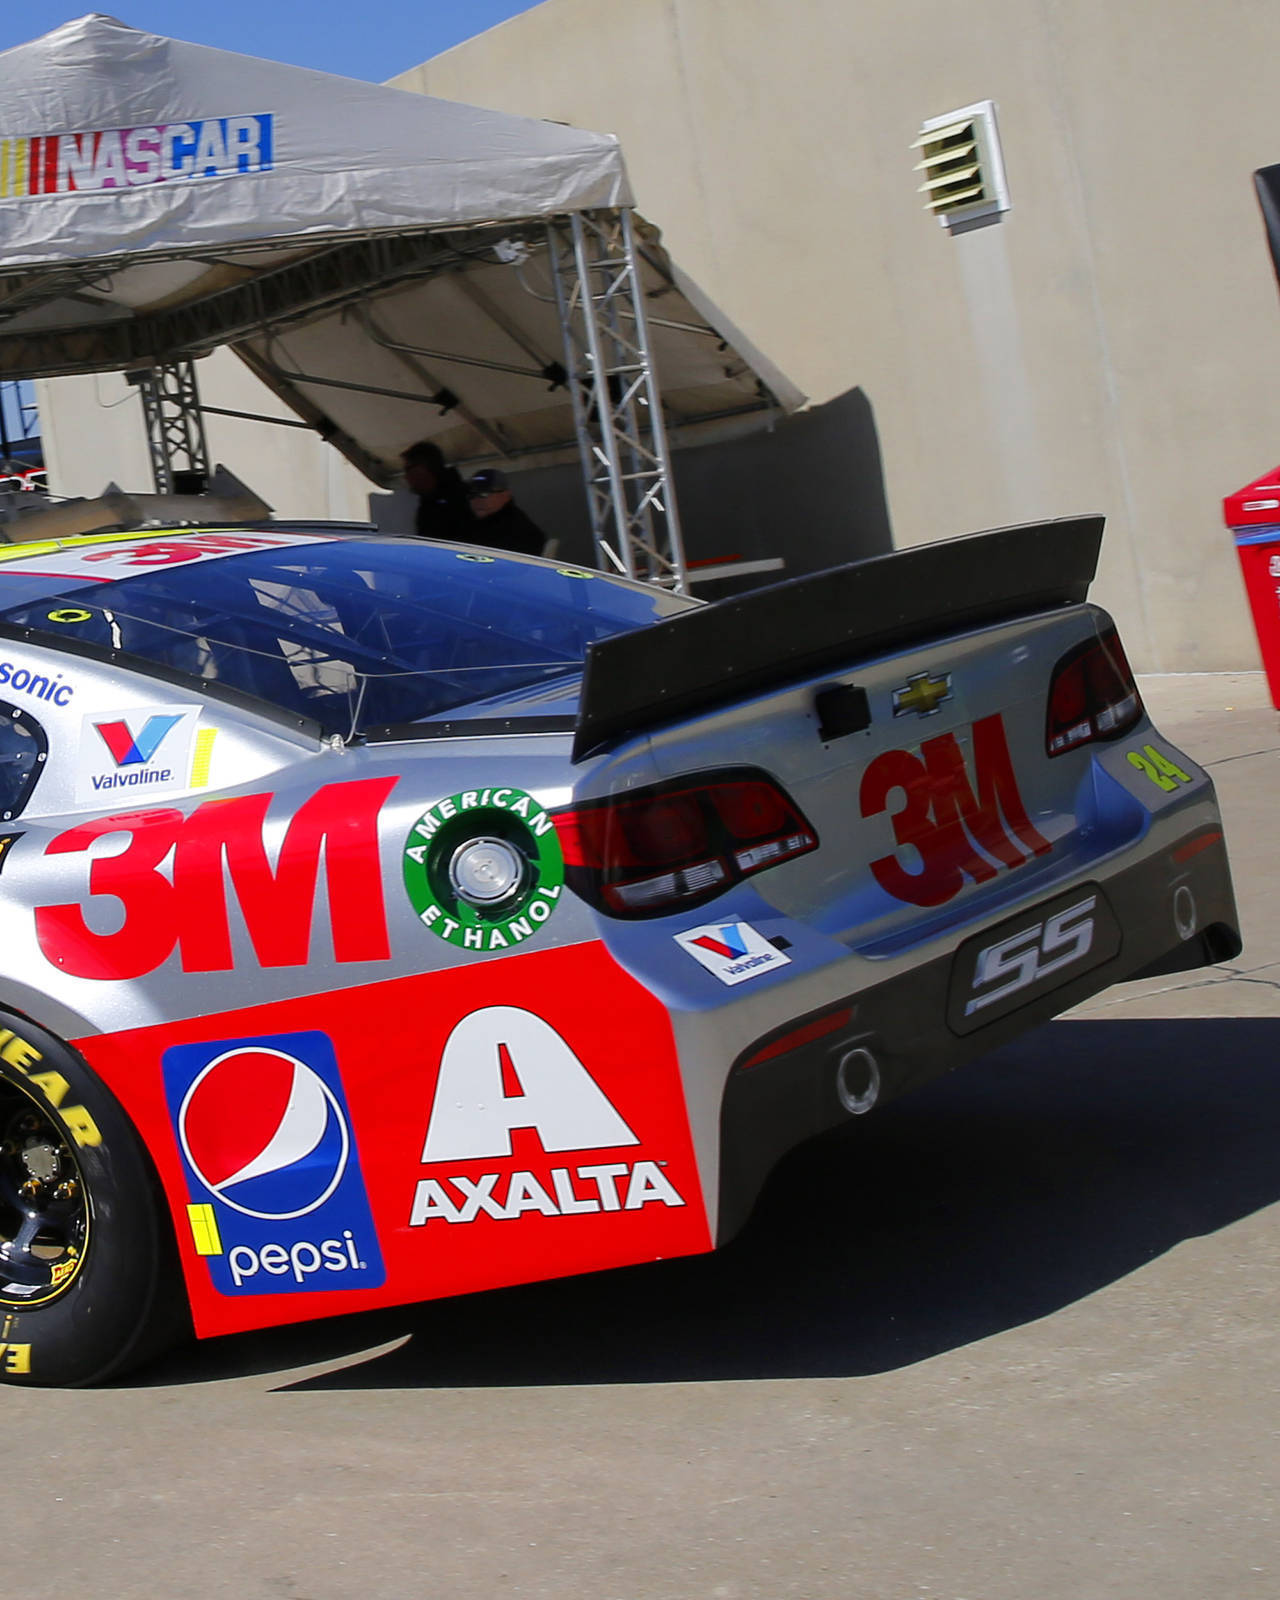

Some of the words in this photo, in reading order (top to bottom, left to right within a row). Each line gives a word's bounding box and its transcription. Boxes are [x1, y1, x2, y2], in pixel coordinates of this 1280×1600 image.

[57, 115, 263, 192] NASCAR
[81, 535, 291, 566] 3M
[91, 768, 173, 790] Valvoline
[1127, 744, 1193, 793] 24
[405, 789, 554, 864] AMERICAN
[860, 713, 1054, 907] 3M
[35, 775, 400, 980] 3M
[420, 885, 561, 949] ETHANOL
[723, 952, 776, 975] Valvoline
[409, 1160, 686, 1226] AXALTA
[228, 1230, 361, 1287] pepsi
